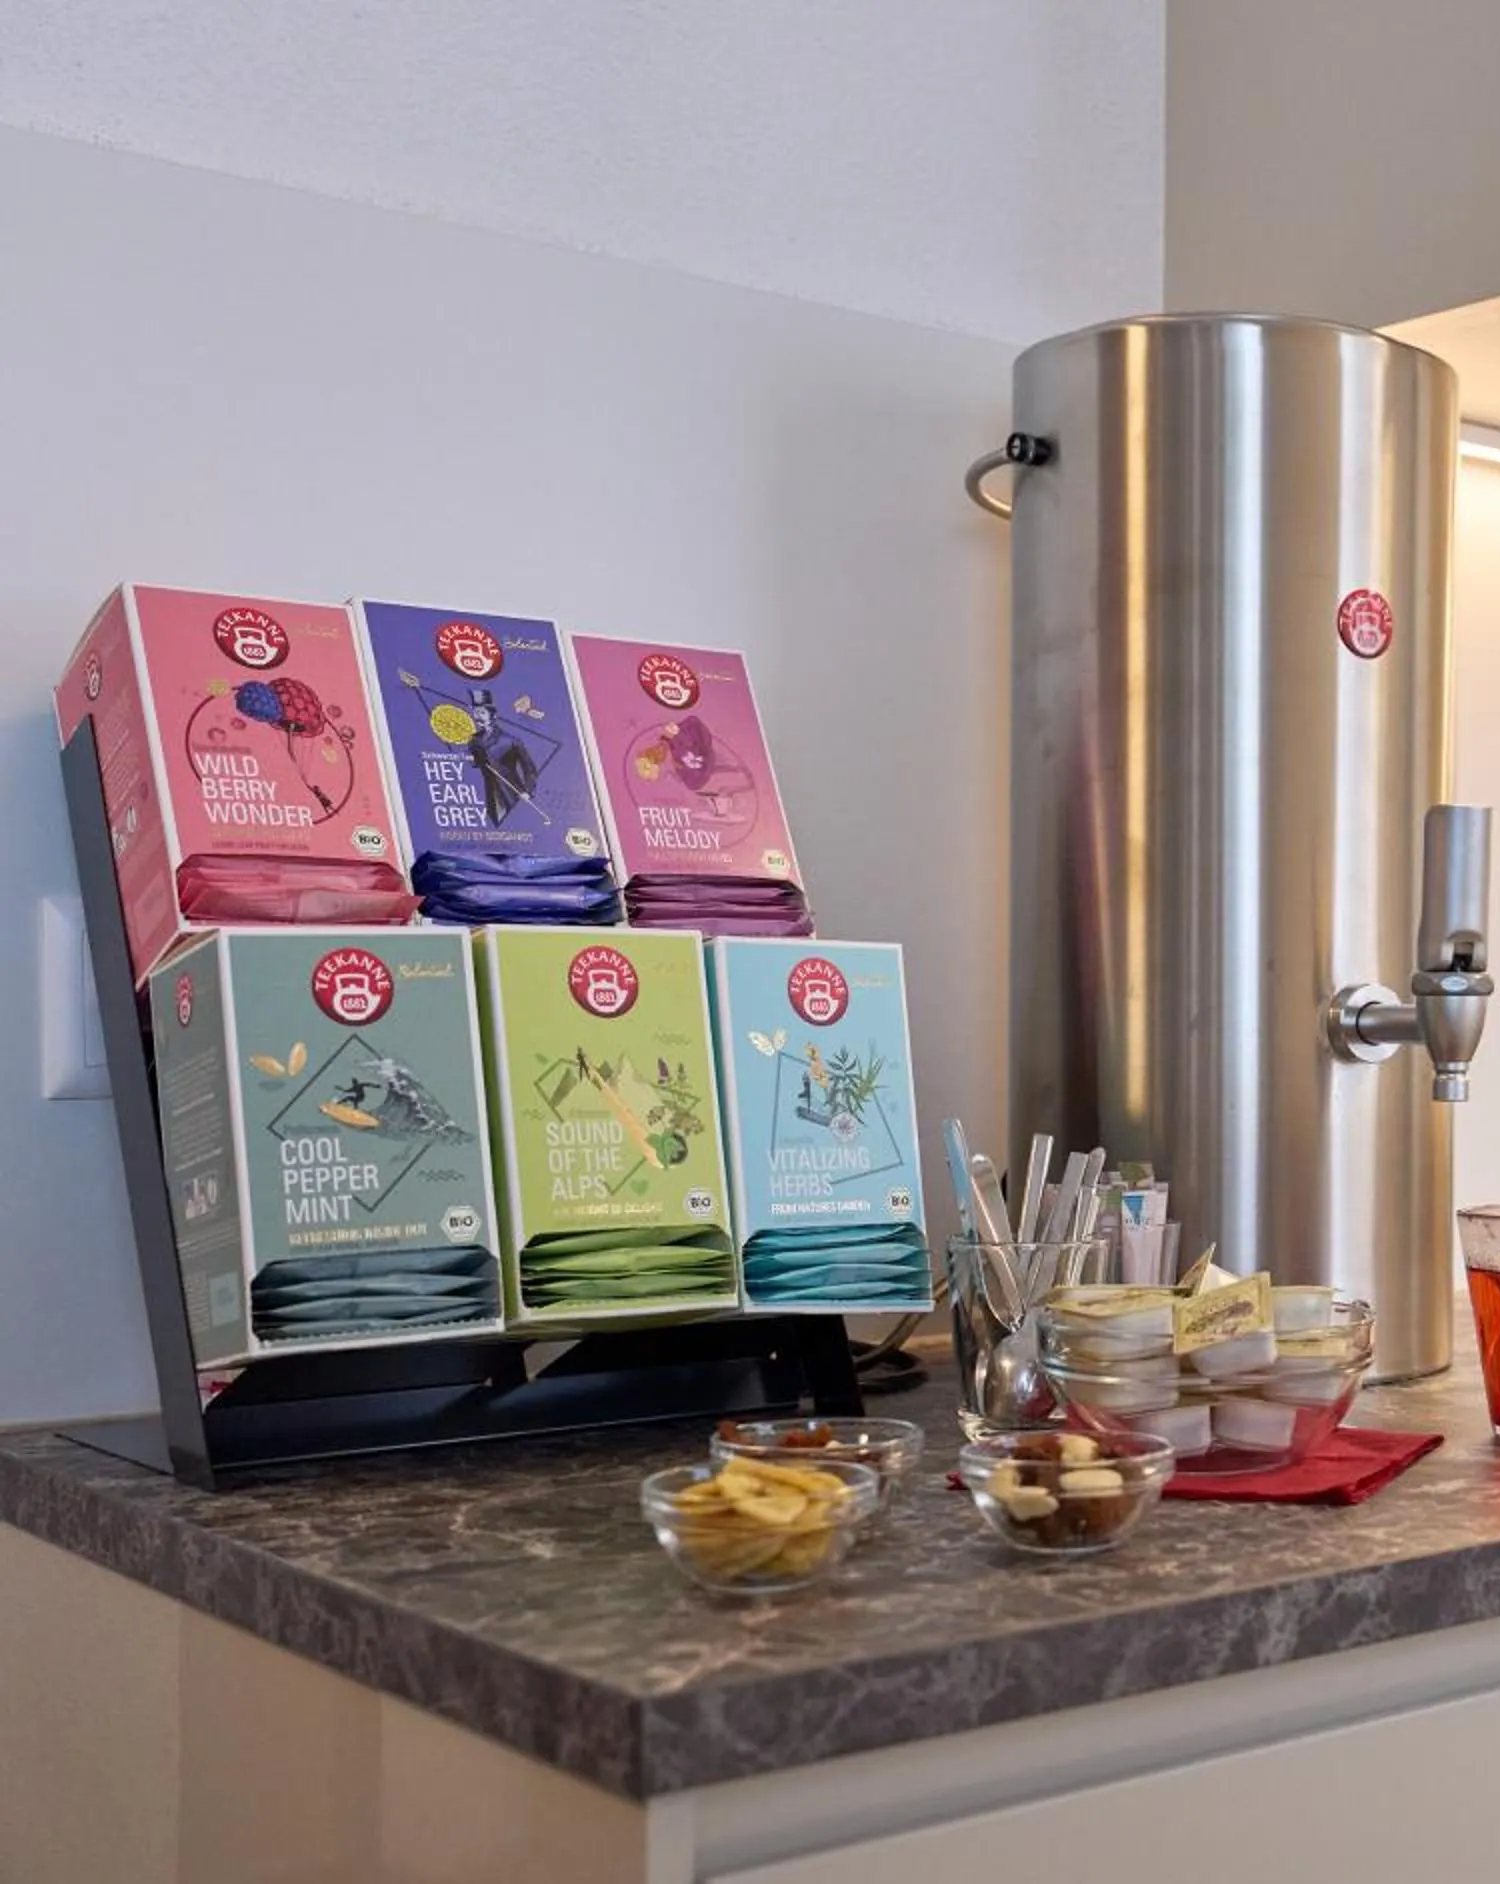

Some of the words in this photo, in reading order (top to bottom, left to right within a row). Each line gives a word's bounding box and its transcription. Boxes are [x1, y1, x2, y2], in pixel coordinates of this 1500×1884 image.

[216, 611, 286, 643] TEEKANNE
[438, 625, 499, 656] TEEKANNE
[195, 752, 259, 777] WILD
[424, 761, 464, 781] HEY
[201, 777, 277, 801] BERRY
[429, 783, 485, 805] EARL
[203, 802, 315, 828] WONDER
[434, 805, 488, 828] GREY
[638, 806, 692, 828] FRUIT
[643, 828, 721, 850] MELODY
[315, 952, 391, 992] TEEKANNE
[571, 951, 637, 985] TEEKANNE
[546, 1120, 624, 1147] SOUND
[280, 1137, 348, 1166] COOL
[549, 1148, 577, 1174] OF
[581, 1146, 625, 1172] THE
[283, 1164, 380, 1194] PEPPER
[552, 1174, 608, 1201] ALPS
[770, 1172, 834, 1197] HERBS
[285, 1194, 353, 1225] MINT
